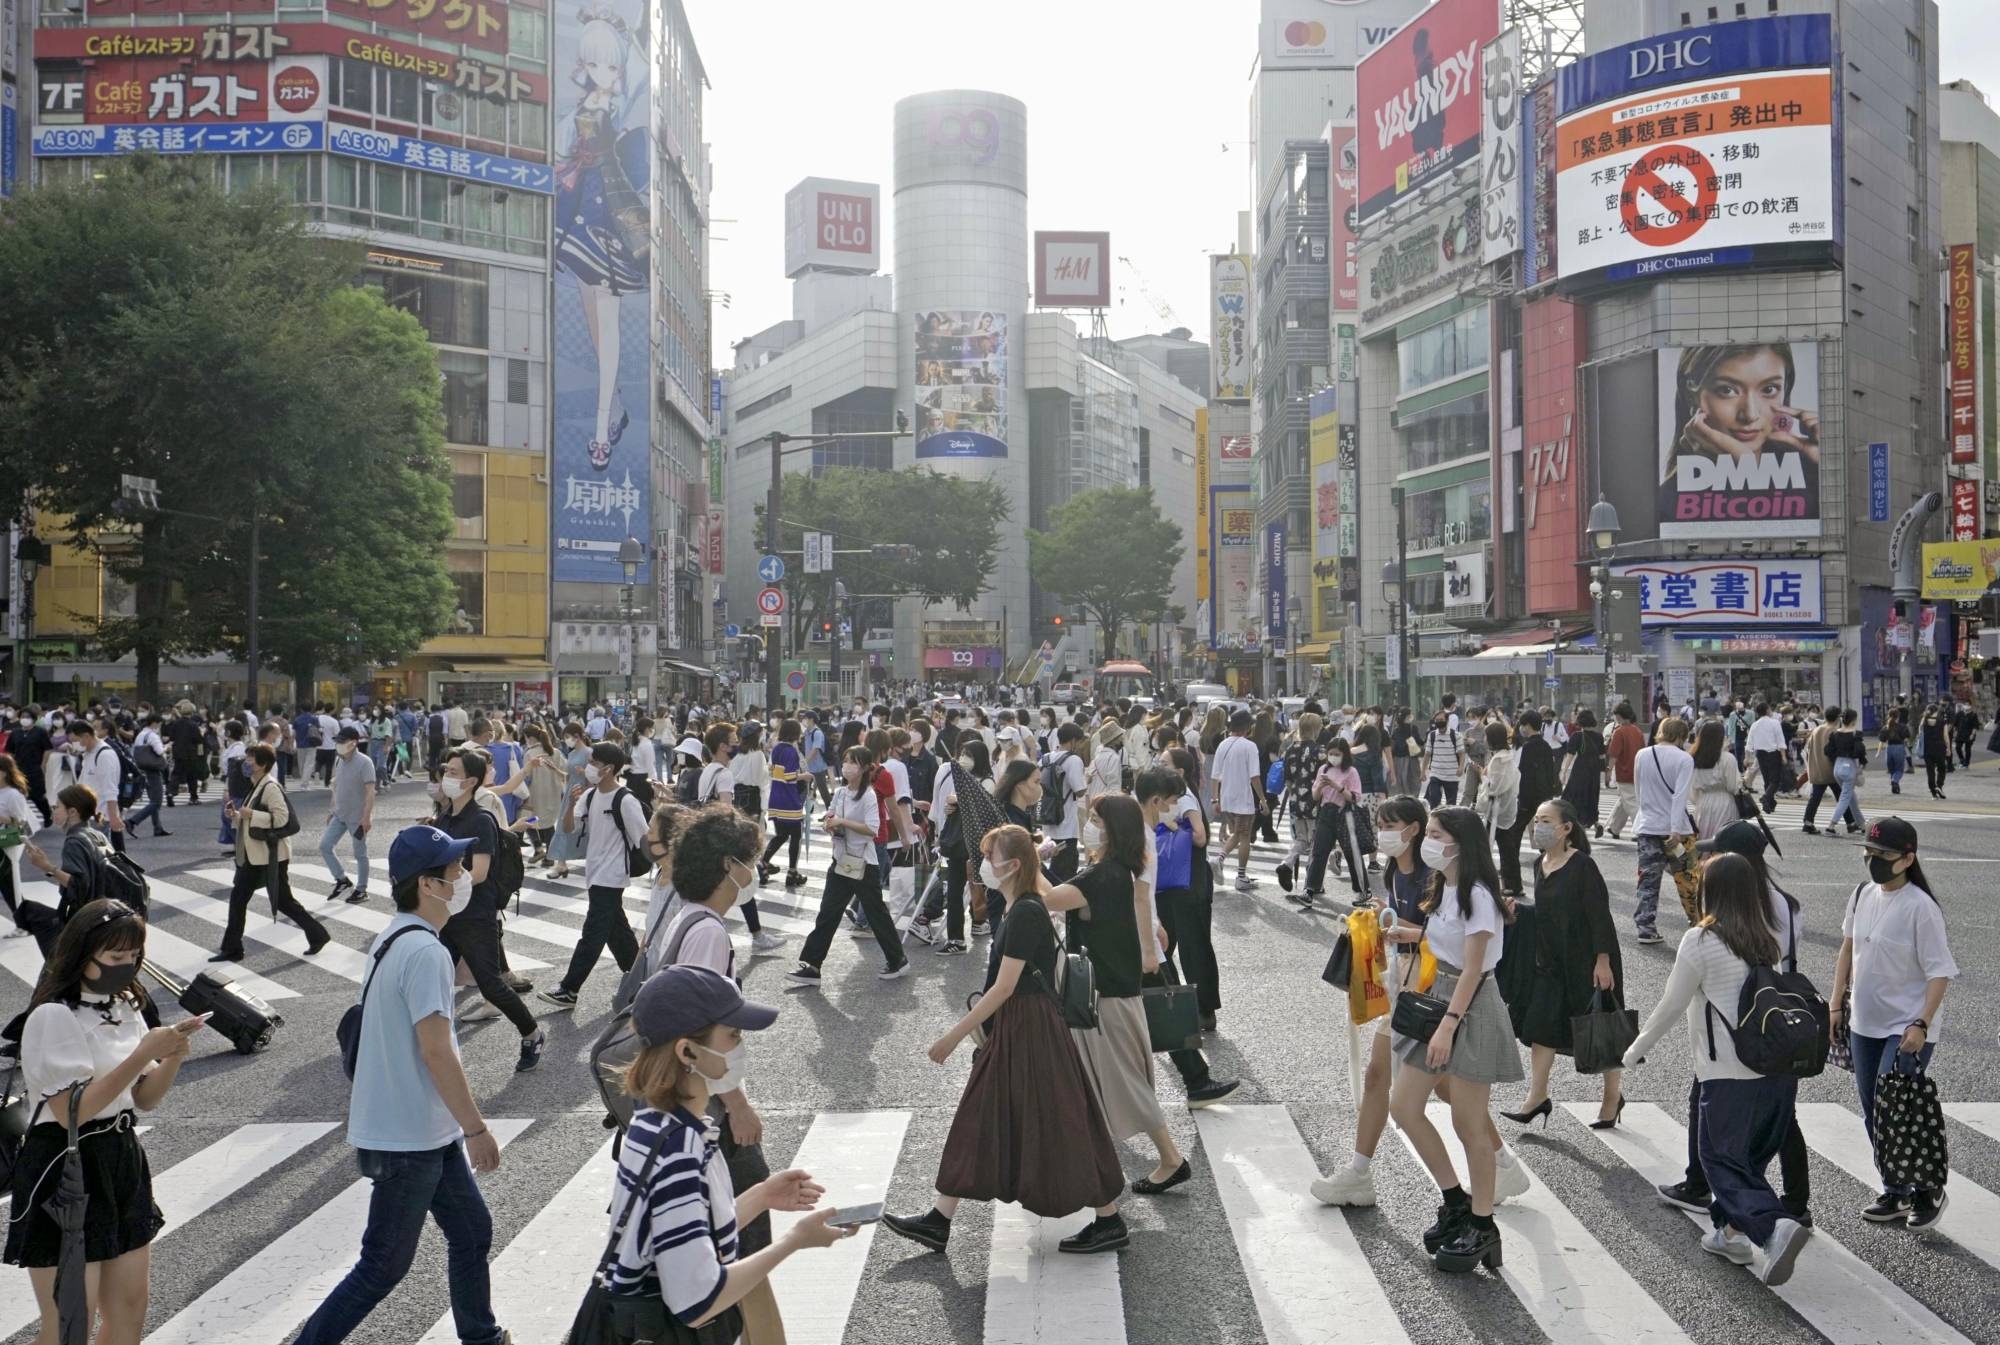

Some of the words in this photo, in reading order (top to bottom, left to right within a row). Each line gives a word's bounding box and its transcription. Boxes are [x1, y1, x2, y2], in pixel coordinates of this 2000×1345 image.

[202, 26, 288, 59] ガスト
[1361, 27, 1398, 45] VIS
[1629, 35, 1712, 80] DHC
[95, 81, 142, 101] Café
[280, 88, 315, 100] ガスト
[455, 60, 531, 100] ガスト
[1374, 39, 1478, 150] VAUNDY
[42, 83, 83, 109] 7F
[96, 102, 142, 114] レストラン
[148, 74, 257, 119] ガスト
[1620, 90, 1730, 119] 新型コロナウイルス感染症
[42, 130, 95, 149] AEON
[112, 127, 275, 150] 英会話イーオン
[286, 129, 311, 143] 6F
[338, 130, 391, 155] AEON
[404, 141, 550, 186] 英会話イーオン
[1591, 142, 1761, 187] 不要不急の外出・移動
[1605, 172, 1743, 211] 密集・密接・密閉
[824, 200, 862, 222] UNI
[1577, 196, 1800, 245] 路上・公園での集団での飲酒
[824, 225, 866, 247] QLO
[1054, 257, 1091, 281] H&M
[1637, 259, 1664, 274] DHC
[1666, 253, 1714, 271] Channel
[1954, 250, 1971, 369] クスリのことなら
[1953, 378, 1975, 454] 三千里
[1676, 452, 1807, 492] DMM
[563, 466, 641, 537] 原神
[1676, 490, 1808, 520] Bitcoin
[1641, 571, 1802, 610] 堂書店
[952, 651, 973, 667] 109
